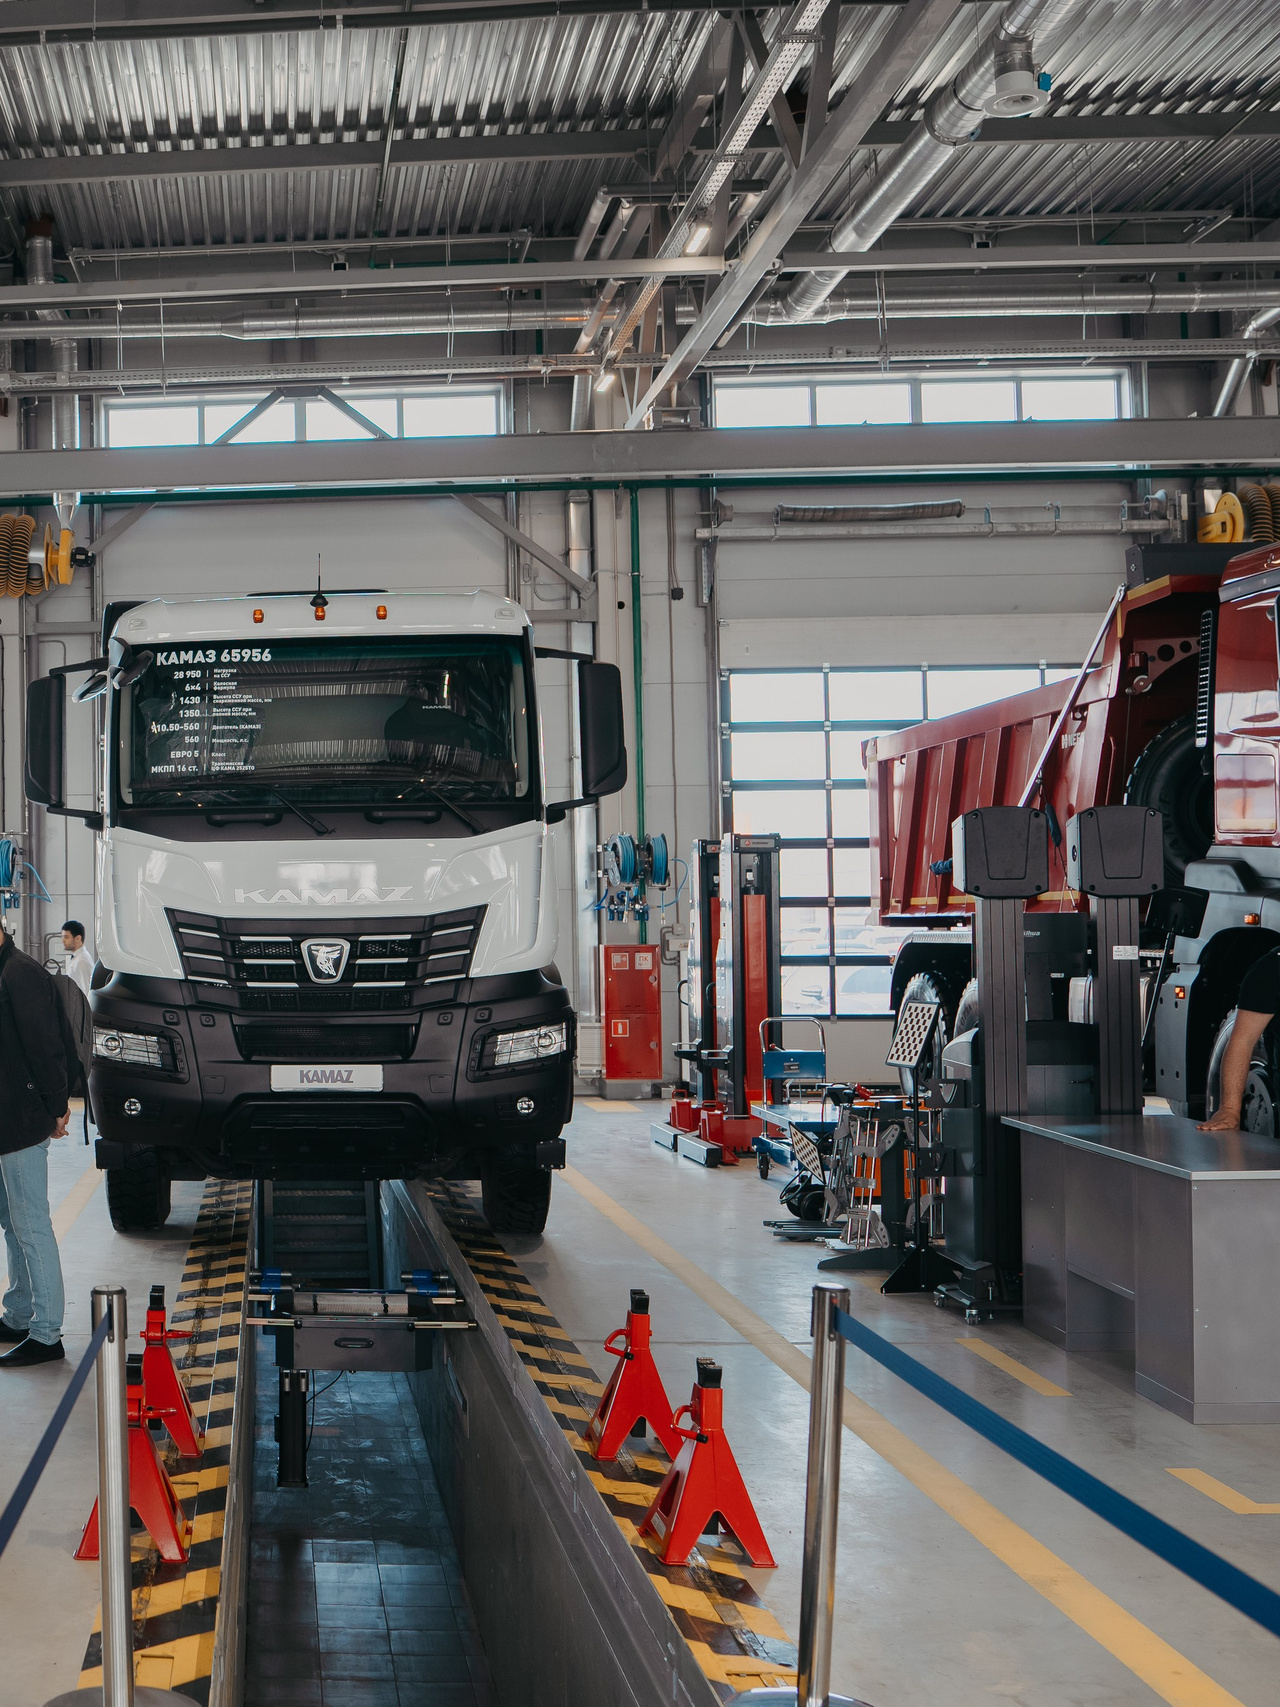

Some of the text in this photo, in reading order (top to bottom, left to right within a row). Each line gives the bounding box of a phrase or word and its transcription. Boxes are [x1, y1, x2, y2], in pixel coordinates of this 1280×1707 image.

[156, 648, 272, 666] КАМАЗ 65956
[173, 670, 201, 679] 28 950
[179, 696, 201, 705] 1430
[179, 709, 200, 718] 1350
[184, 735, 200, 743] 560
[170, 750, 199, 759] ЕВРО 5
[151, 766, 175, 774] МКПП
[233, 886, 415, 904] KAMAZ
[299, 1069, 354, 1084] KAMAZ
